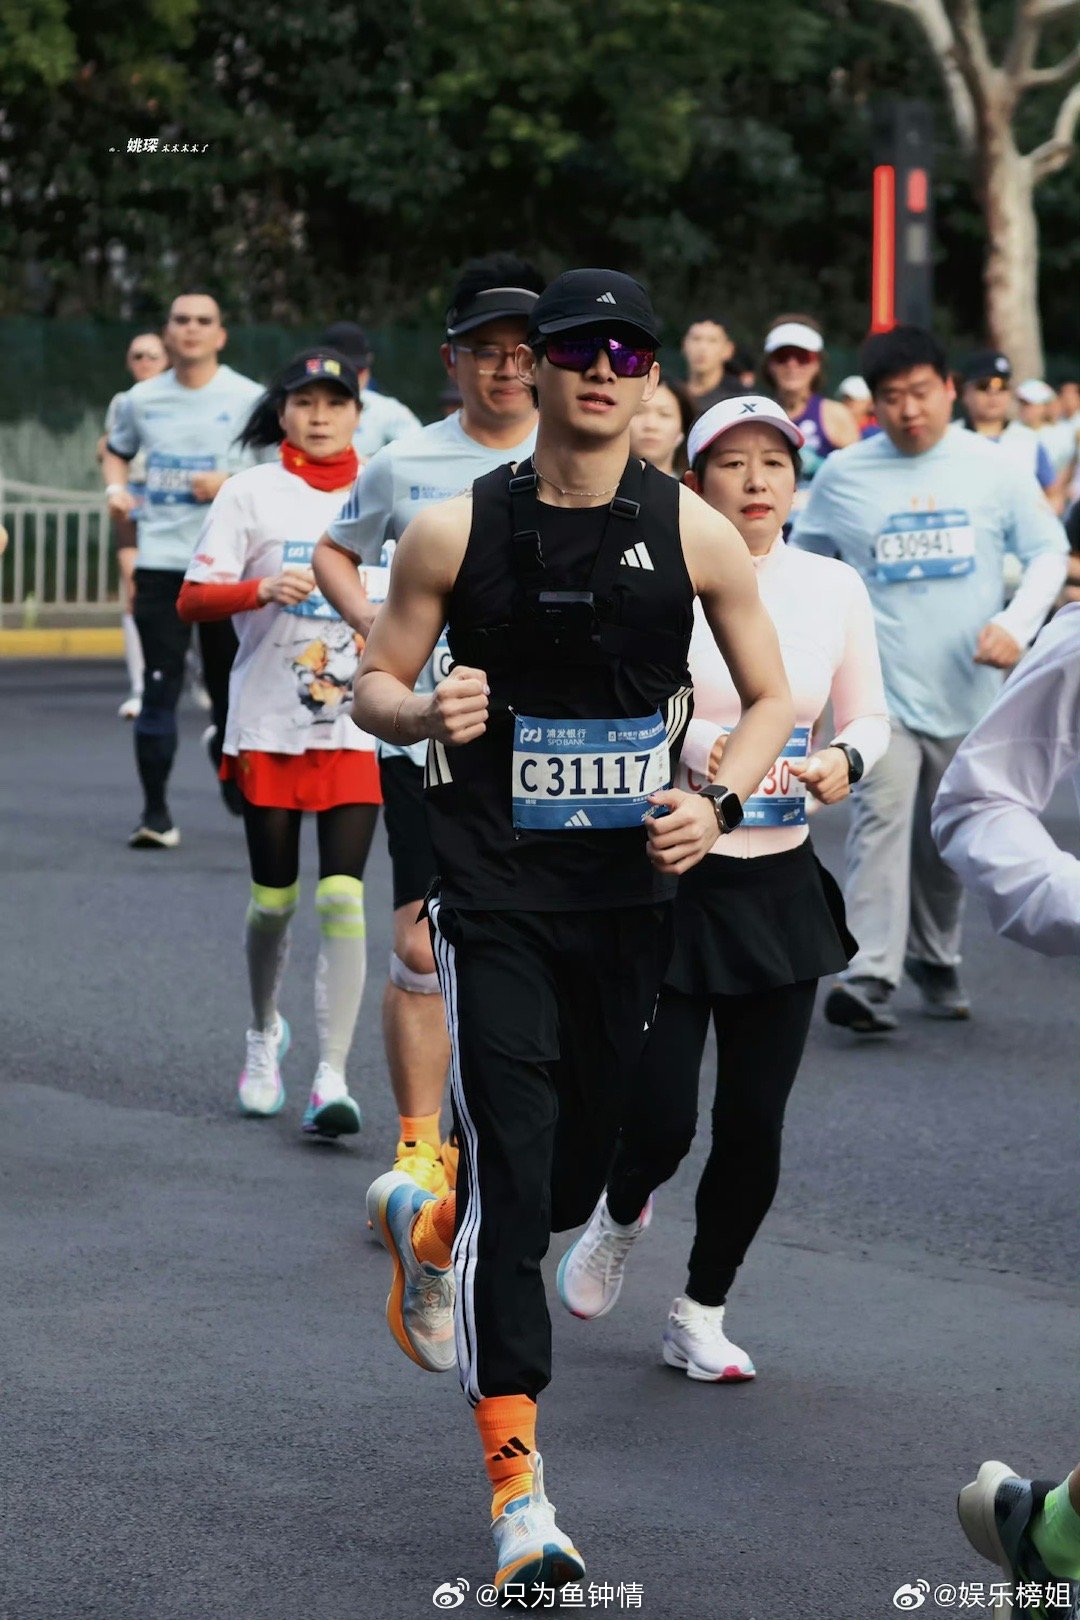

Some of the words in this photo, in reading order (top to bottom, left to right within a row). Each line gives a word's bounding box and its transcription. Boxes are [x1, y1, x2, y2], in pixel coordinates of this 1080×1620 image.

[881, 531, 954, 559] C30941
[546, 728, 587, 738] 浦发银行
[547, 738, 563, 746] SPD
[564, 738, 586, 746] BANK
[520, 753, 651, 797] C31117
